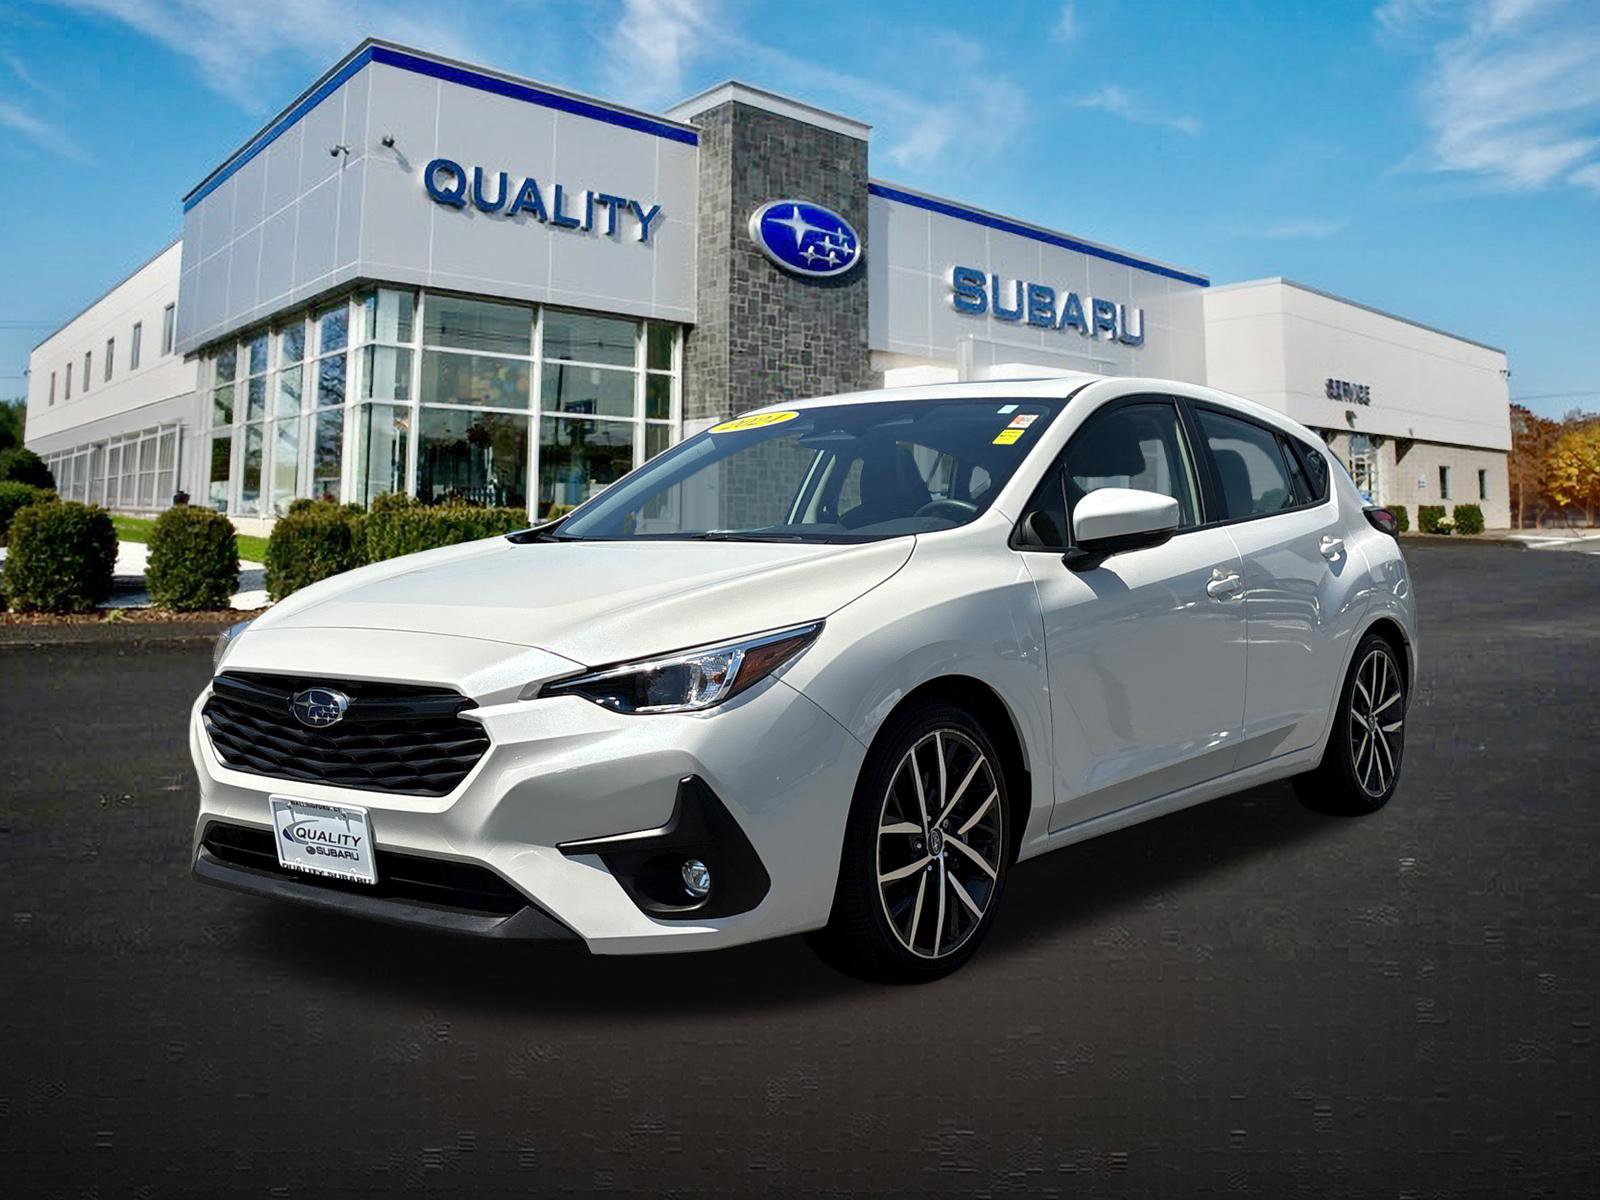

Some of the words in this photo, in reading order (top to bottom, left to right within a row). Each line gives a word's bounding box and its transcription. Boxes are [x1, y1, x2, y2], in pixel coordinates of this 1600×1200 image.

[424, 158, 662, 243] QUALITY
[948, 265, 1144, 347] SUBARU
[1325, 378, 1371, 407] SERVICE
[296, 827, 362, 847] QUALITY
[316, 846, 360, 861] SUBARU
